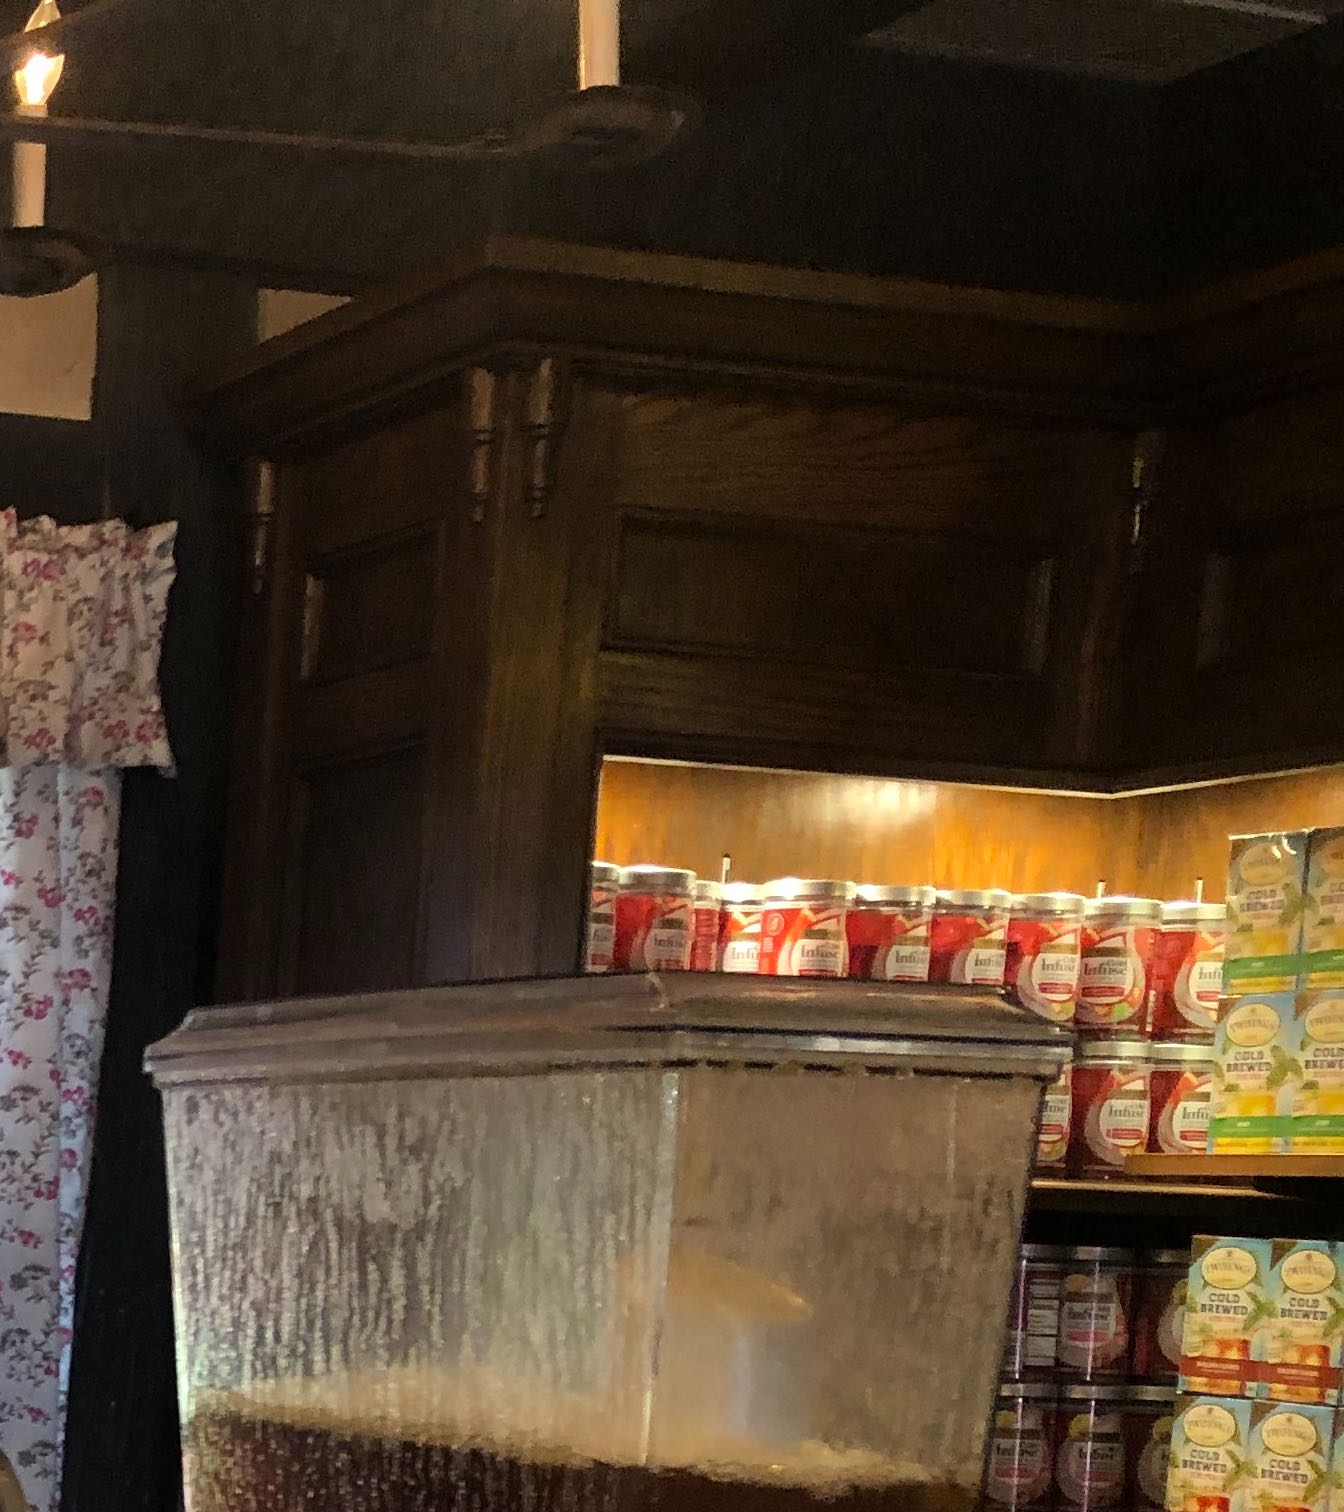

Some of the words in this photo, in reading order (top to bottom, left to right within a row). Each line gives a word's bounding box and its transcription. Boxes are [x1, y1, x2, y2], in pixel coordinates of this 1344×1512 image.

[1083, 962, 1128, 976] Infuse
[1235, 1050, 1264, 1061] COLD
[1226, 1061, 1272, 1073] BREWED
[1305, 1059, 1344, 1070] BREWE
[1209, 1292, 1240, 1302] COLD
[1289, 1295, 1319, 1307] COLD
[1201, 1302, 1248, 1314] BREWED
[1280, 1306, 1328, 1319] BREWED
[1190, 1447, 1221, 1459] COLD
[1182, 1458, 1227, 1472] BREWED
[1269, 1458, 1301, 1469] COLD
[1261, 1467, 1308, 1483] BREWED
